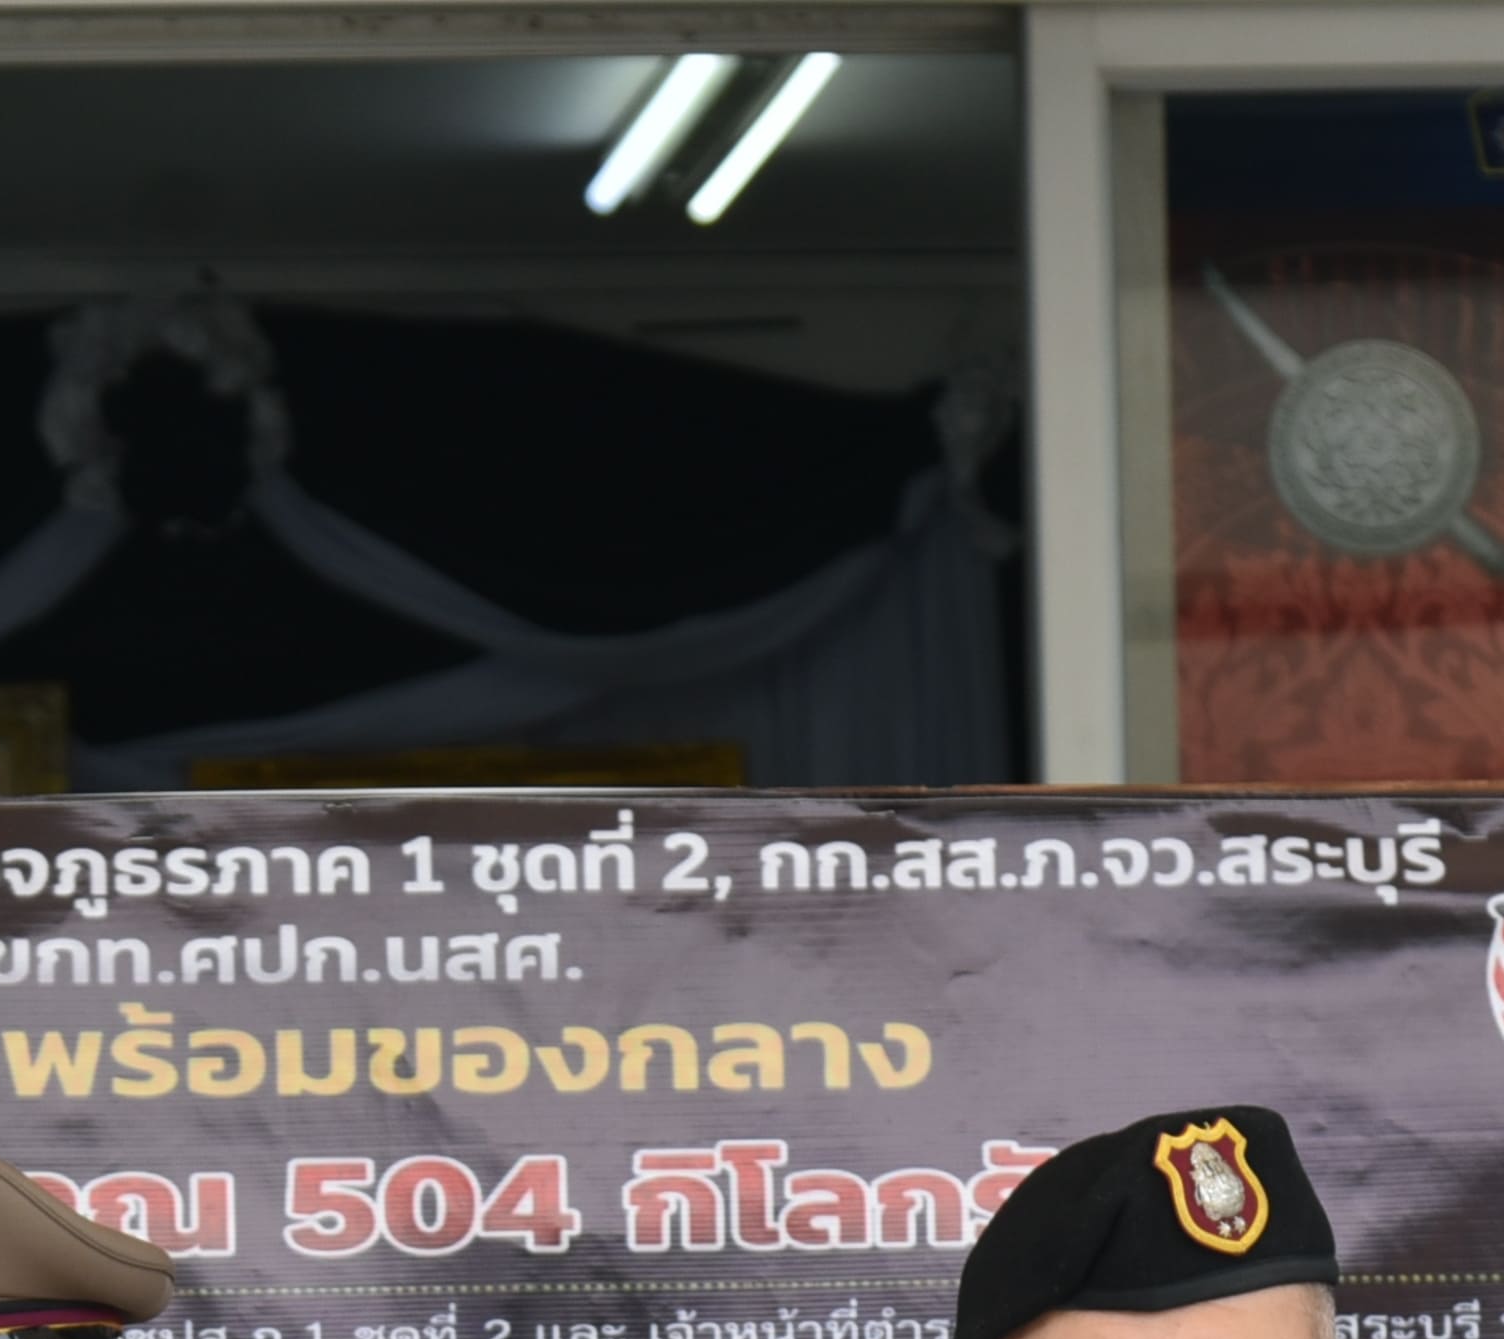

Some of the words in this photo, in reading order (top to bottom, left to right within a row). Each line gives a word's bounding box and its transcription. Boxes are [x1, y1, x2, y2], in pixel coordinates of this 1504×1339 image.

[399, 836, 446, 894] 1
[471, 810, 638, 915] ชุดที่
[662, 832, 734, 902] 2,
[759, 817, 1448, 905] กก.สส.ภ.จว.สระบุรี
[285, 1153, 582, 1261] 504
[623, 1138, 1060, 1254] กิโลกรั
